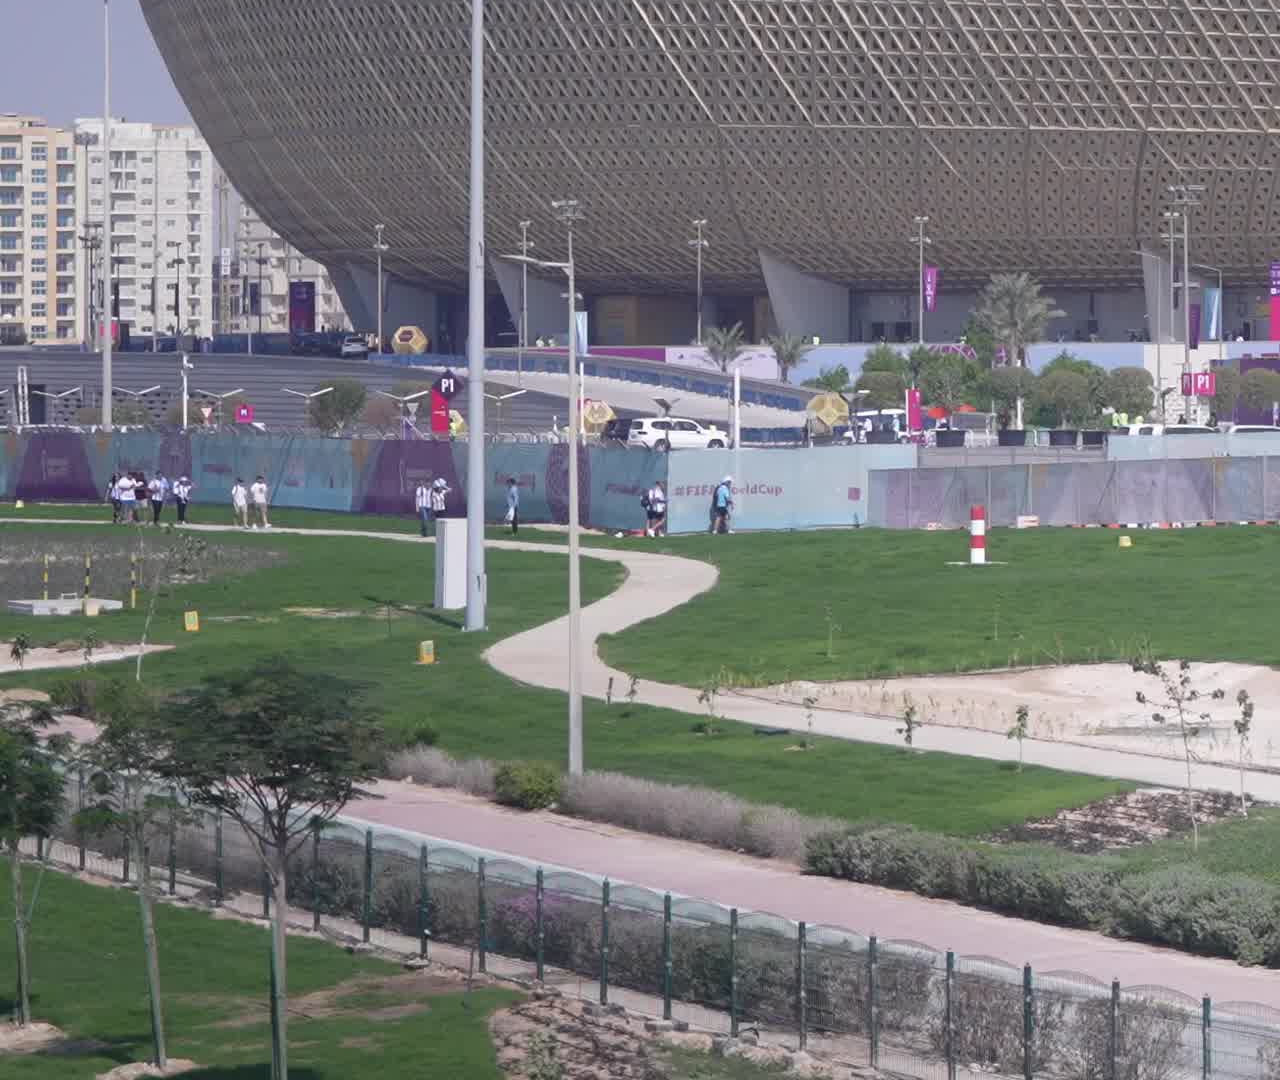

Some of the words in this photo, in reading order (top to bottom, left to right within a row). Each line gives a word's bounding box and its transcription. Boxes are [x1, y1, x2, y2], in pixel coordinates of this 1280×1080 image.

[441, 378, 454, 392] P1
[1197, 374, 1209, 389] P1
[240, 408, 248, 416] M
[672, 482, 783, 497] #FIFAorldCup
